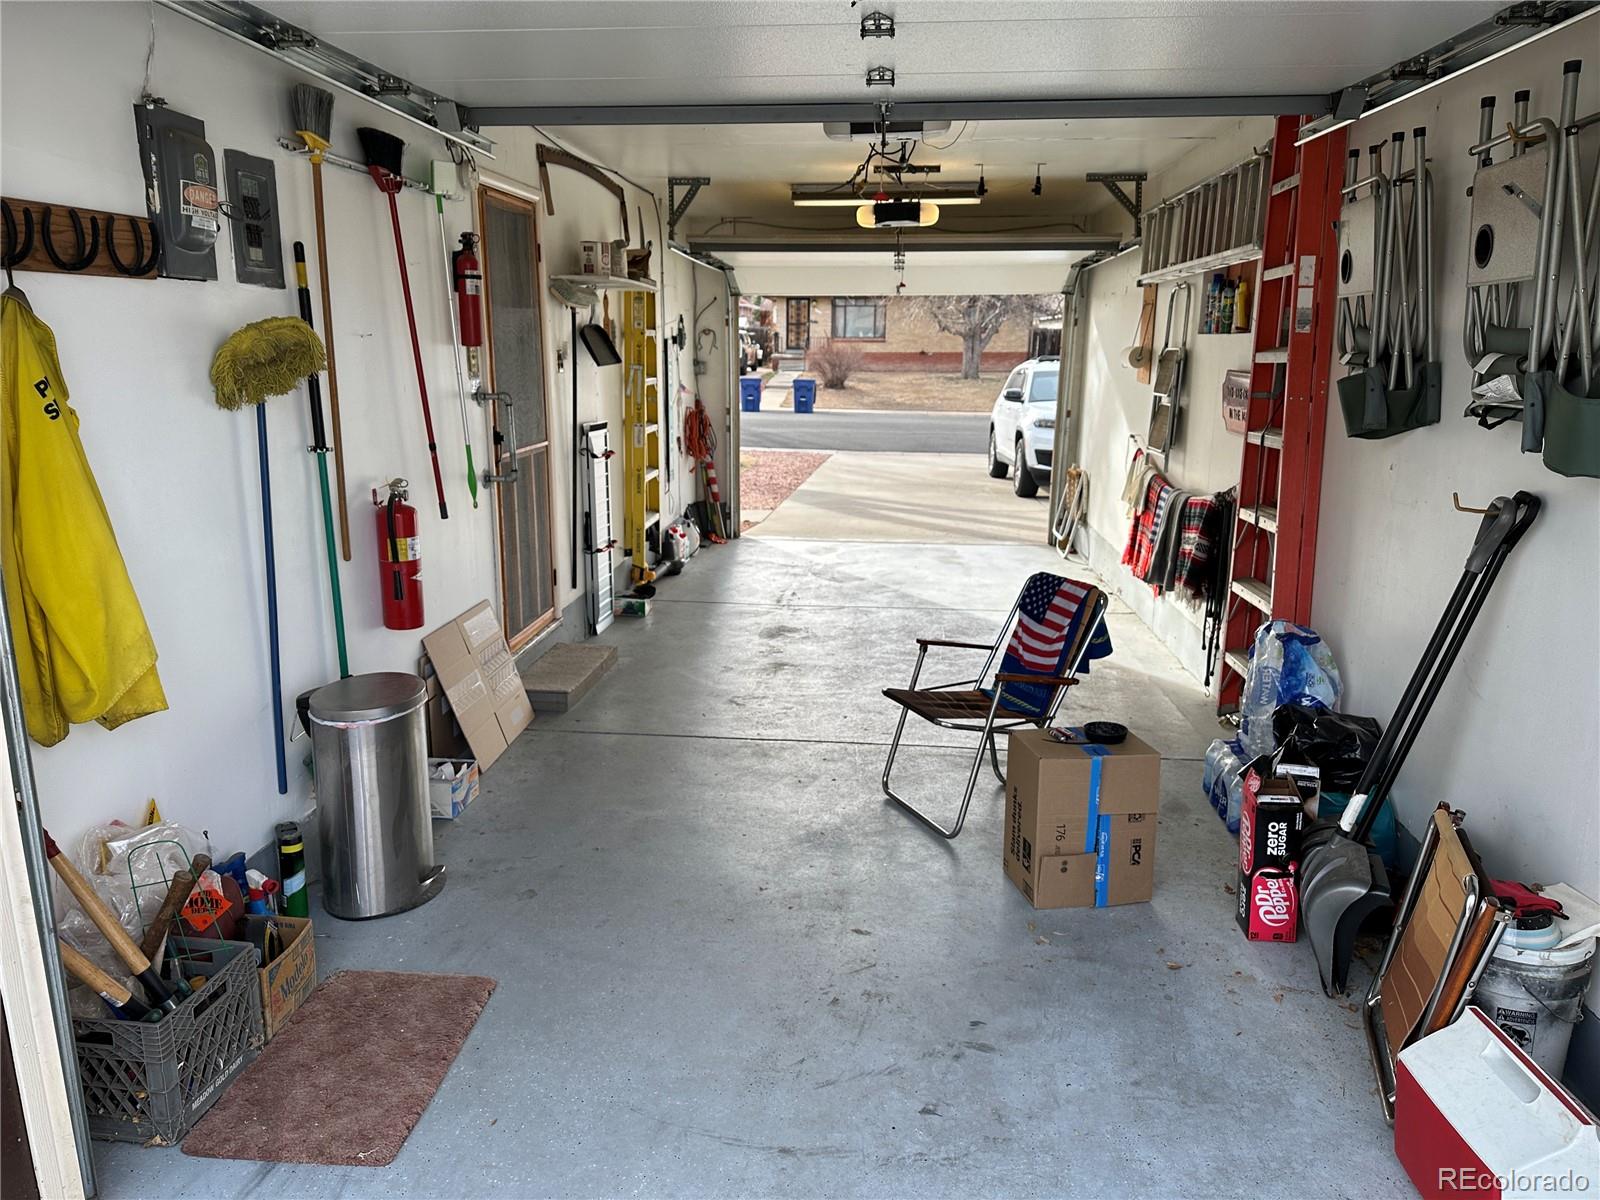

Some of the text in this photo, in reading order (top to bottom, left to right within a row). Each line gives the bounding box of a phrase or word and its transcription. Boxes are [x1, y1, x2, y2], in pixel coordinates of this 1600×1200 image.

[189, 187, 218, 204] DANGE
[1055, 823, 1066, 842] 176
[1266, 821, 1279, 856] zero
[1278, 822, 1288, 856] SUGAR
[1255, 885, 1274, 906] Dr
[192, 1055, 243, 1110] MEADOW GOLD DAIRY
